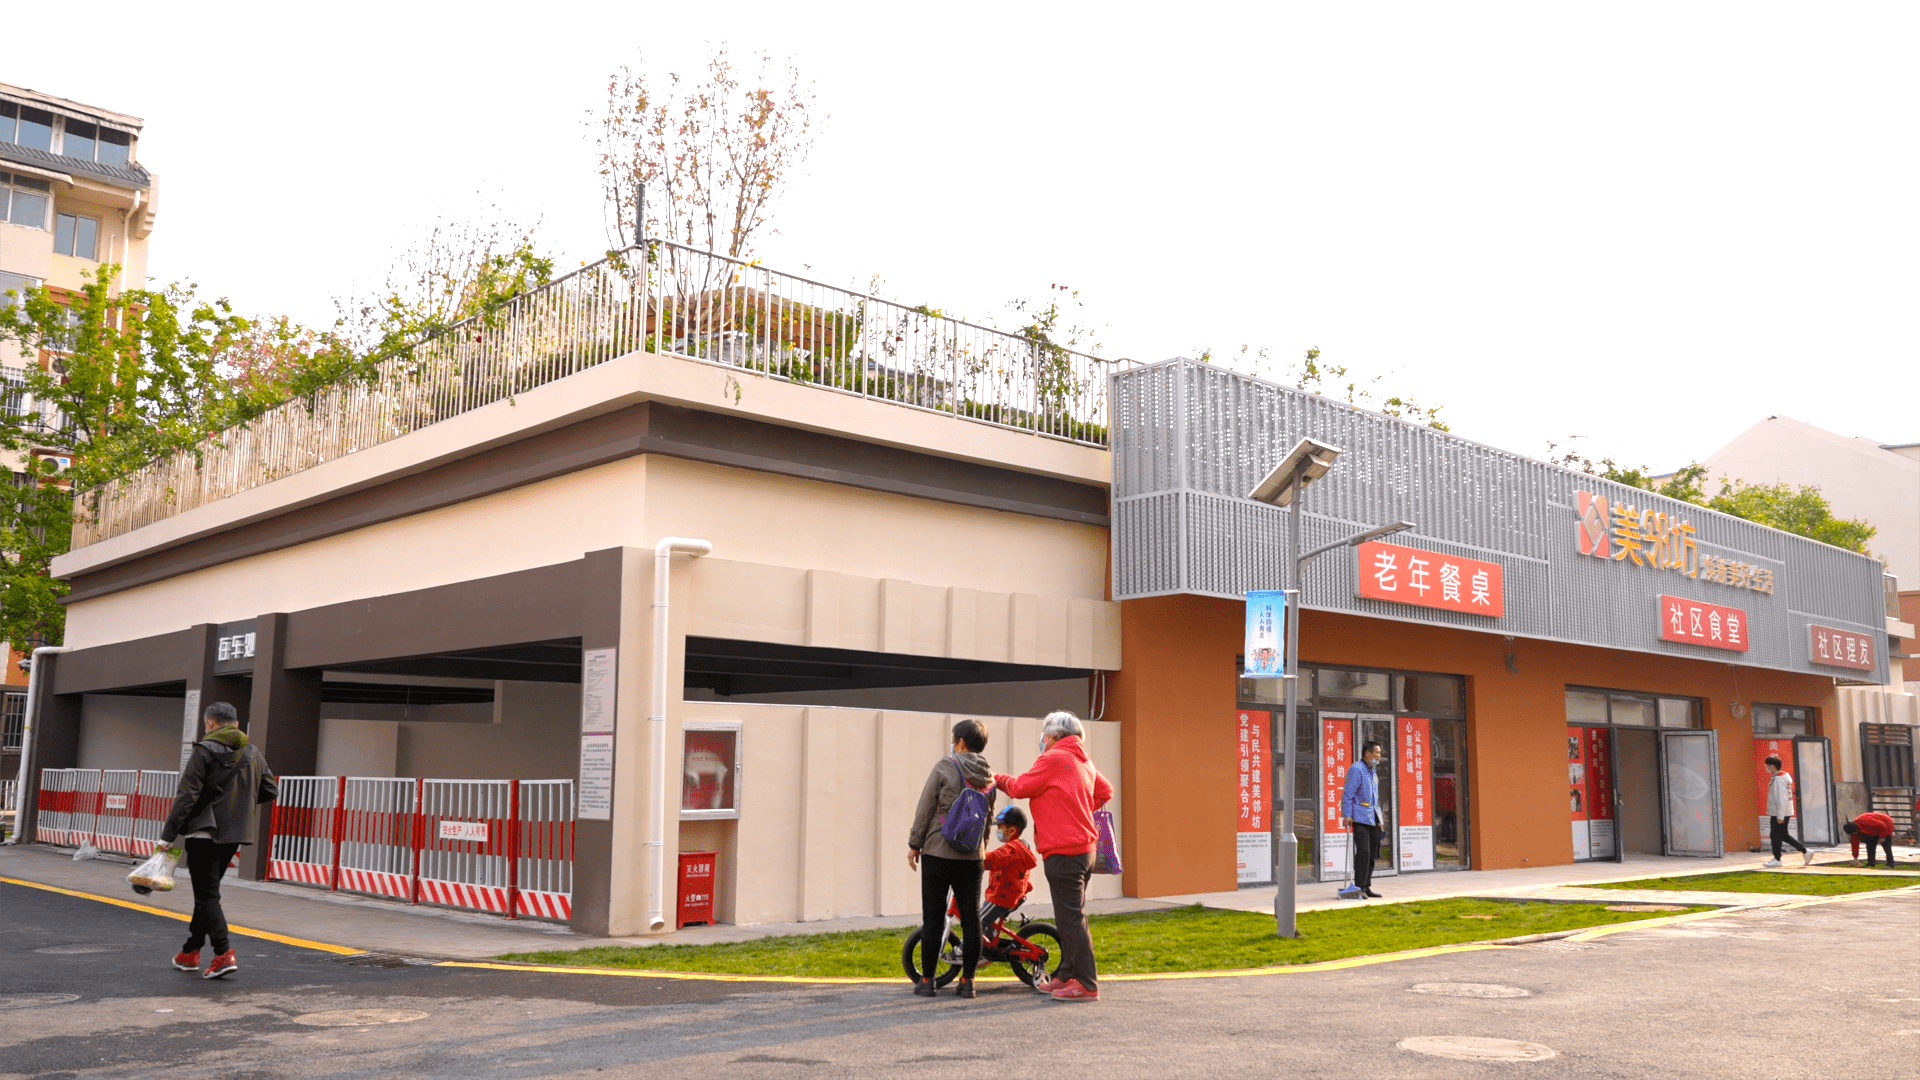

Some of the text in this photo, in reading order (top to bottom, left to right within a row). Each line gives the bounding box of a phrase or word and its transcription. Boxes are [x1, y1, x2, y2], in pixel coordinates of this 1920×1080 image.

[1374, 550, 1491, 606] 老年餐桌
[1610, 502, 1698, 579] 美邻坊
[1670, 603, 1741, 644] 社区食堂
[1818, 631, 1870, 665] 社区理发
[1240, 713, 1250, 819] 党建引领聚合力
[1251, 723, 1261, 829] 与民共建美邻坊
[1326, 721, 1336, 820] 十分钟生活圈
